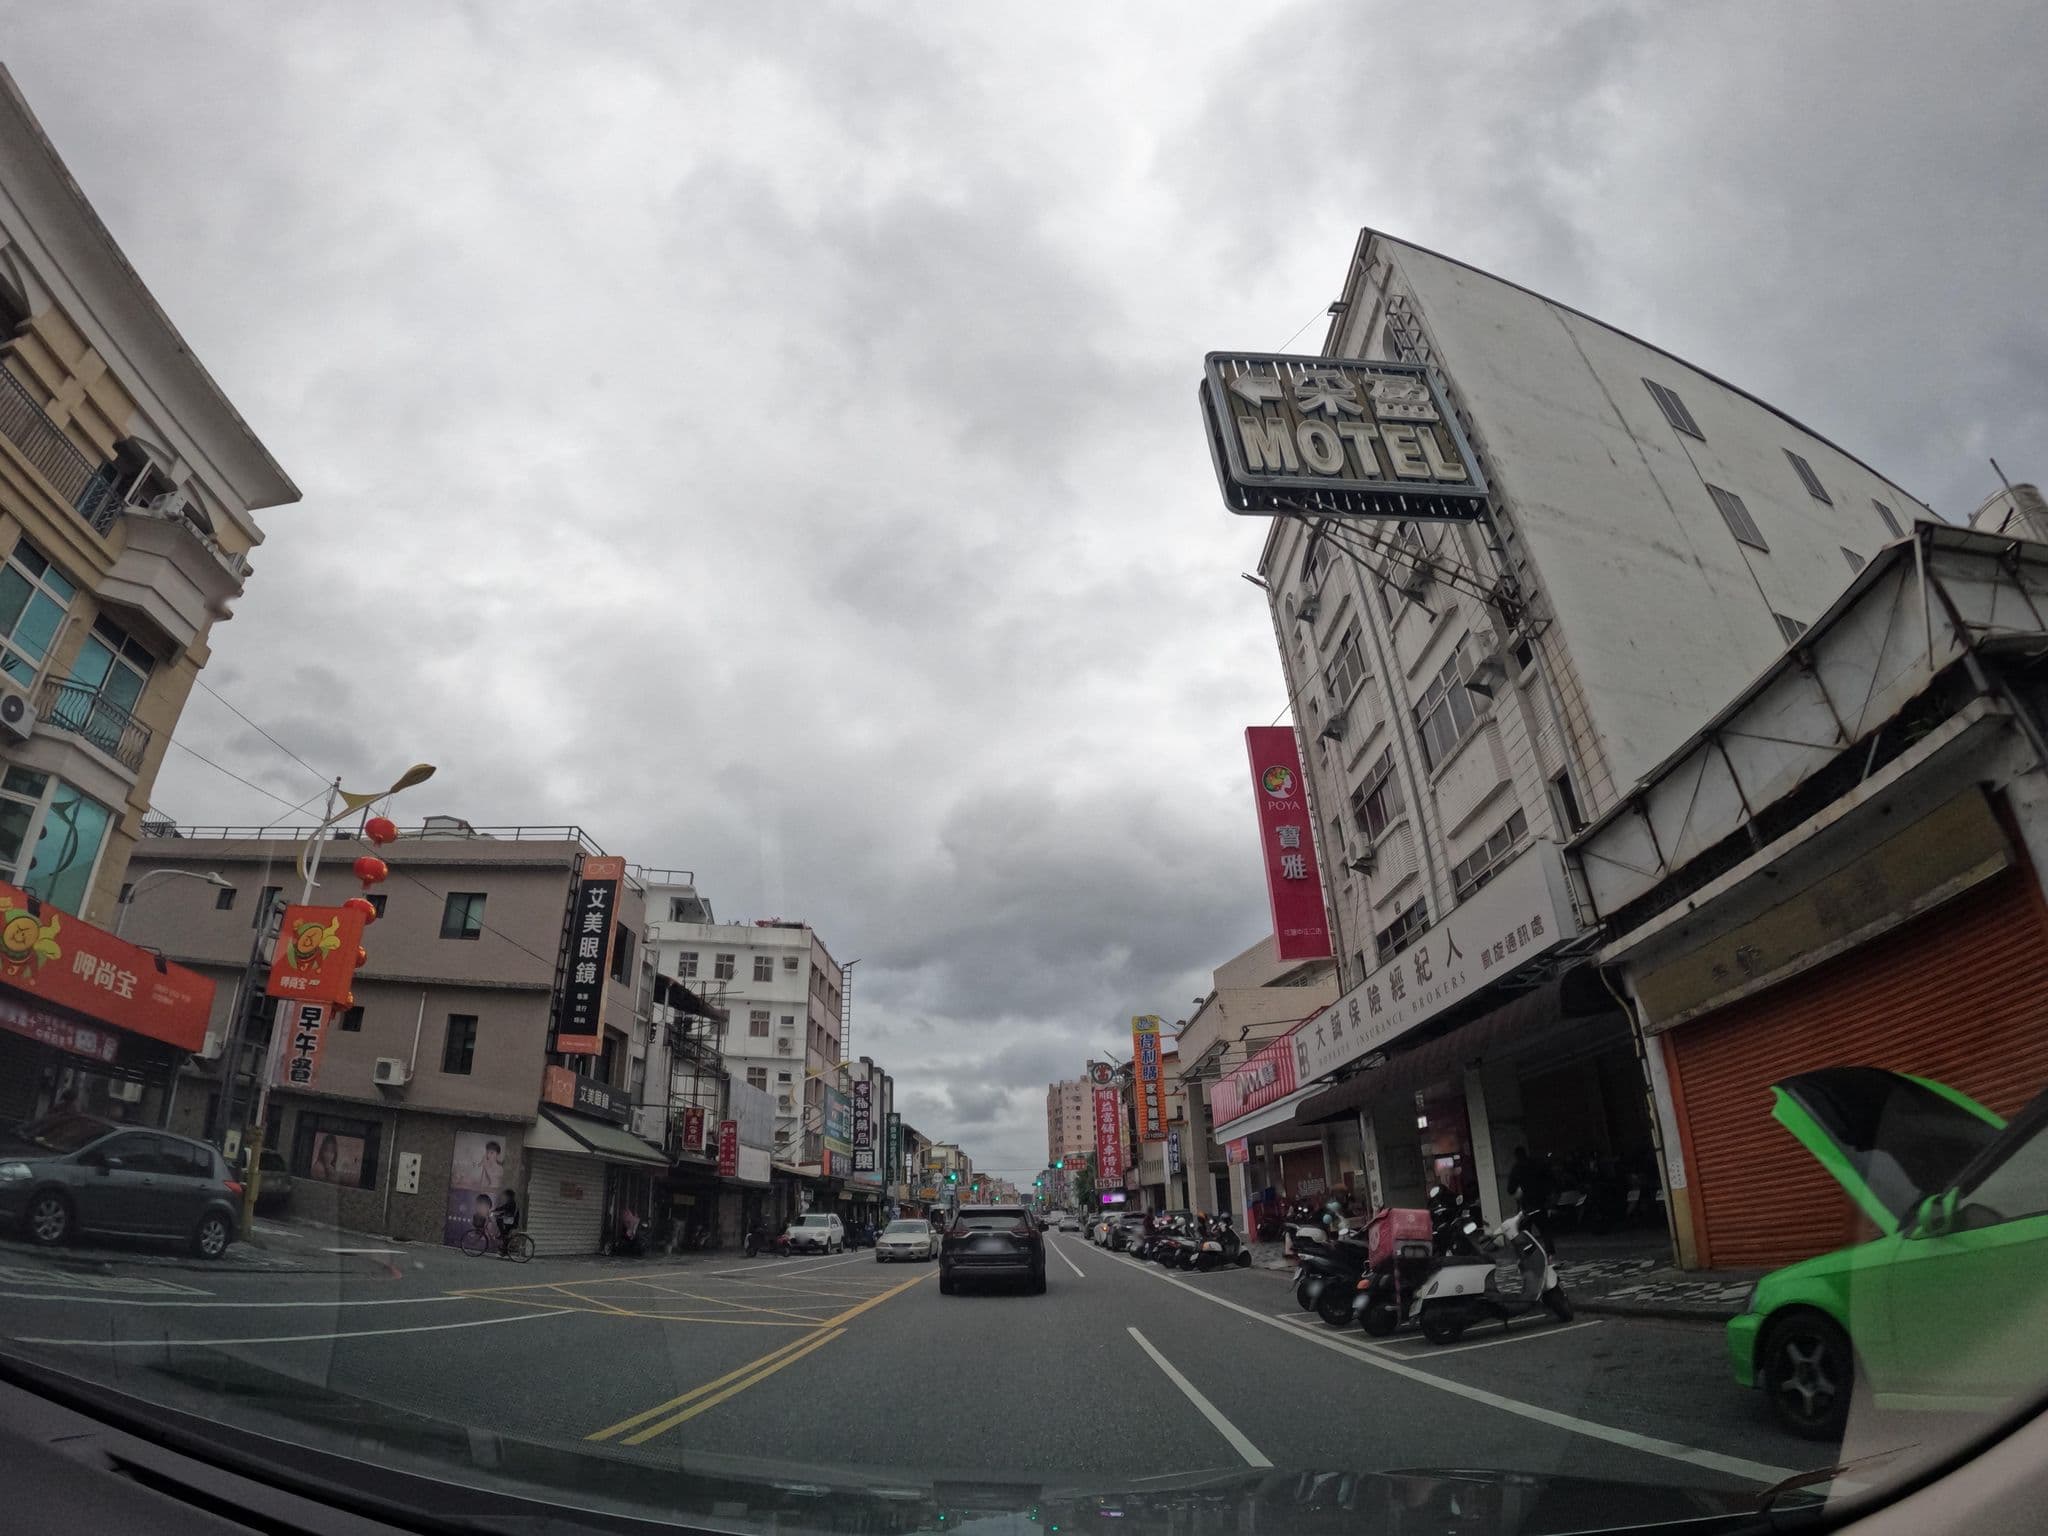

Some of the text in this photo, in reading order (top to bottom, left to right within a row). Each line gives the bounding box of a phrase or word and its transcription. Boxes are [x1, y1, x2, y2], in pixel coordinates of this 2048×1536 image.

[1237, 415, 1467, 482] MOTEL
[1268, 800, 1300, 811] POYA
[1276, 825, 1308, 880] 寶雅
[575, 887, 608, 985] 艾美眼鏡
[1480, 914, 1545, 970] 凱旋通訊處
[1356, 1010, 1403, 1048] INSURANCE
[1411, 970, 1467, 1014] BROKERS
[289, 1005, 323, 1084] 早午餐
[579, 1085, 609, 1109] 艾美眼鏡
